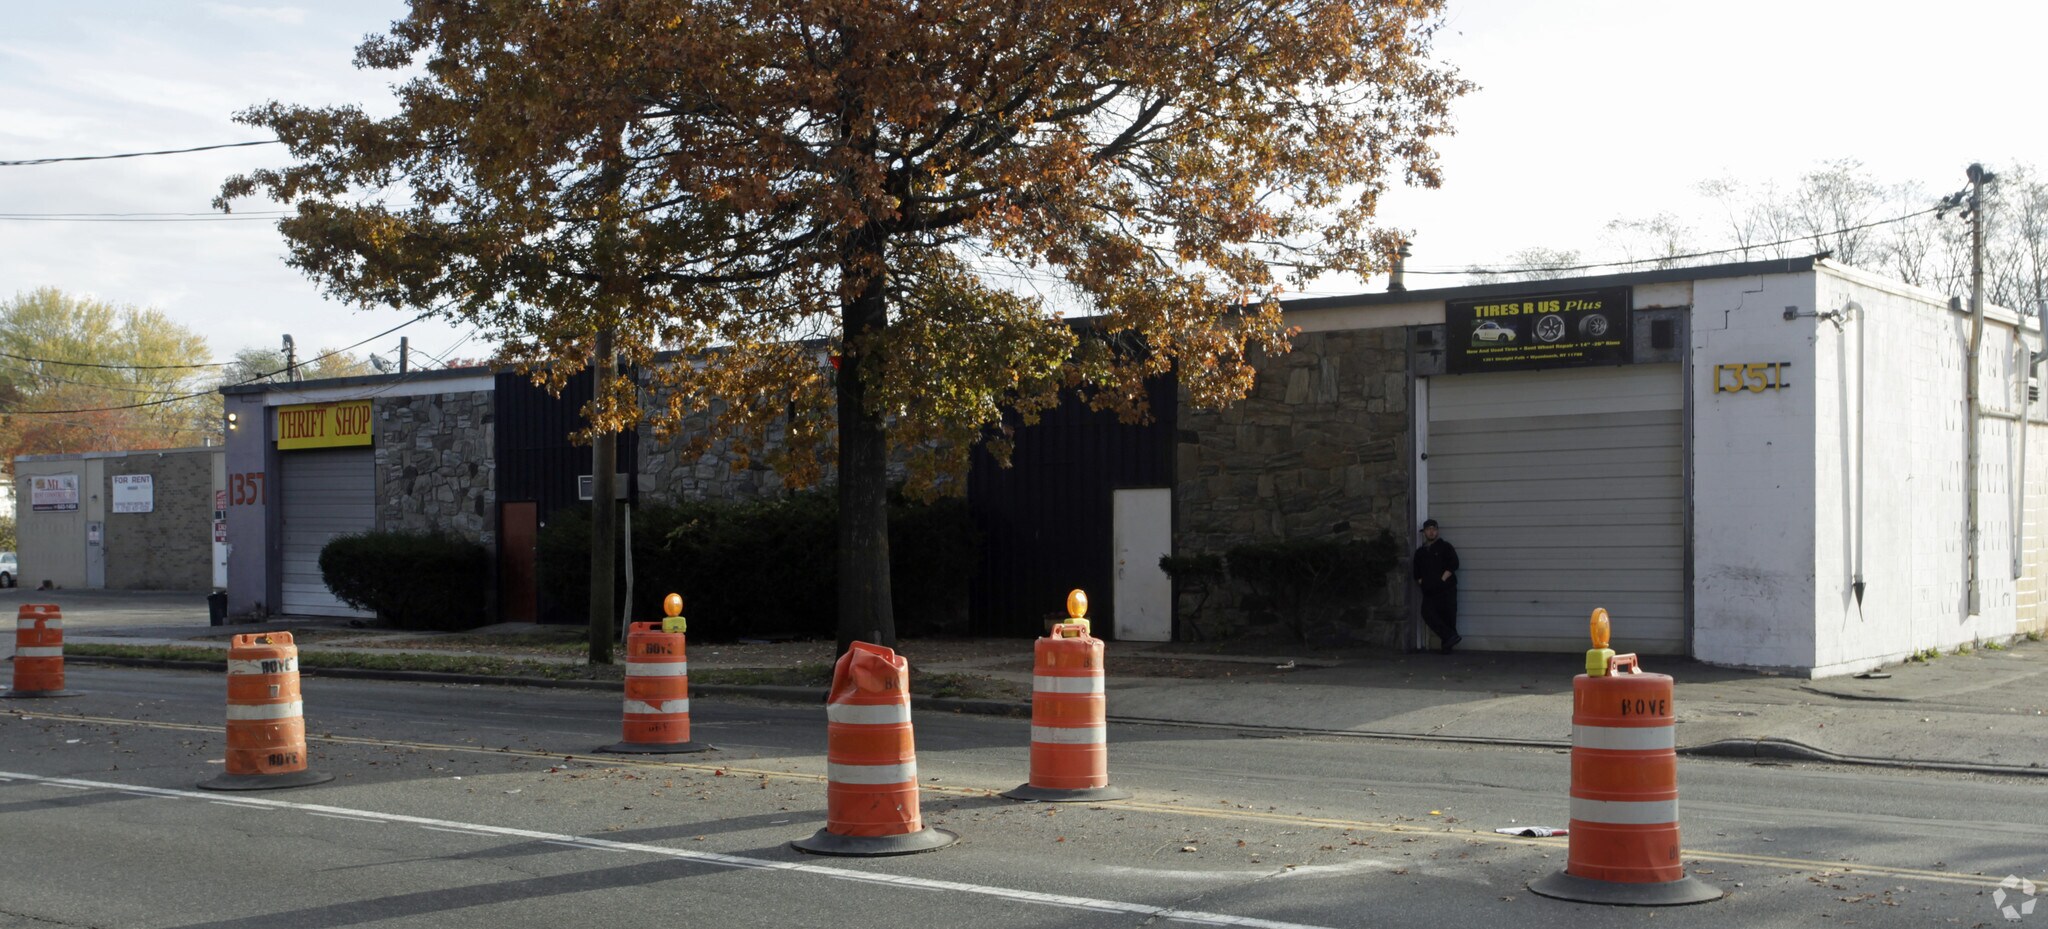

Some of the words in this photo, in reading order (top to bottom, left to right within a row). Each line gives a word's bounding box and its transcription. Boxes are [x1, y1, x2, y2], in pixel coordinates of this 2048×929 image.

[1474, 303, 1519, 318] TIRES
[1523, 302, 1534, 314] R
[1538, 300, 1561, 313] US
[1564, 299, 1602, 312] Plus
[1713, 362, 1781, 394] 1351
[279, 408, 327, 439] THRIFT
[335, 405, 370, 436] SHOP
[229, 472, 265, 506] 1357
[261, 658, 292, 674] BOVE
[1621, 698, 1666, 716] BOVE
[268, 751, 299, 767] BOVE
